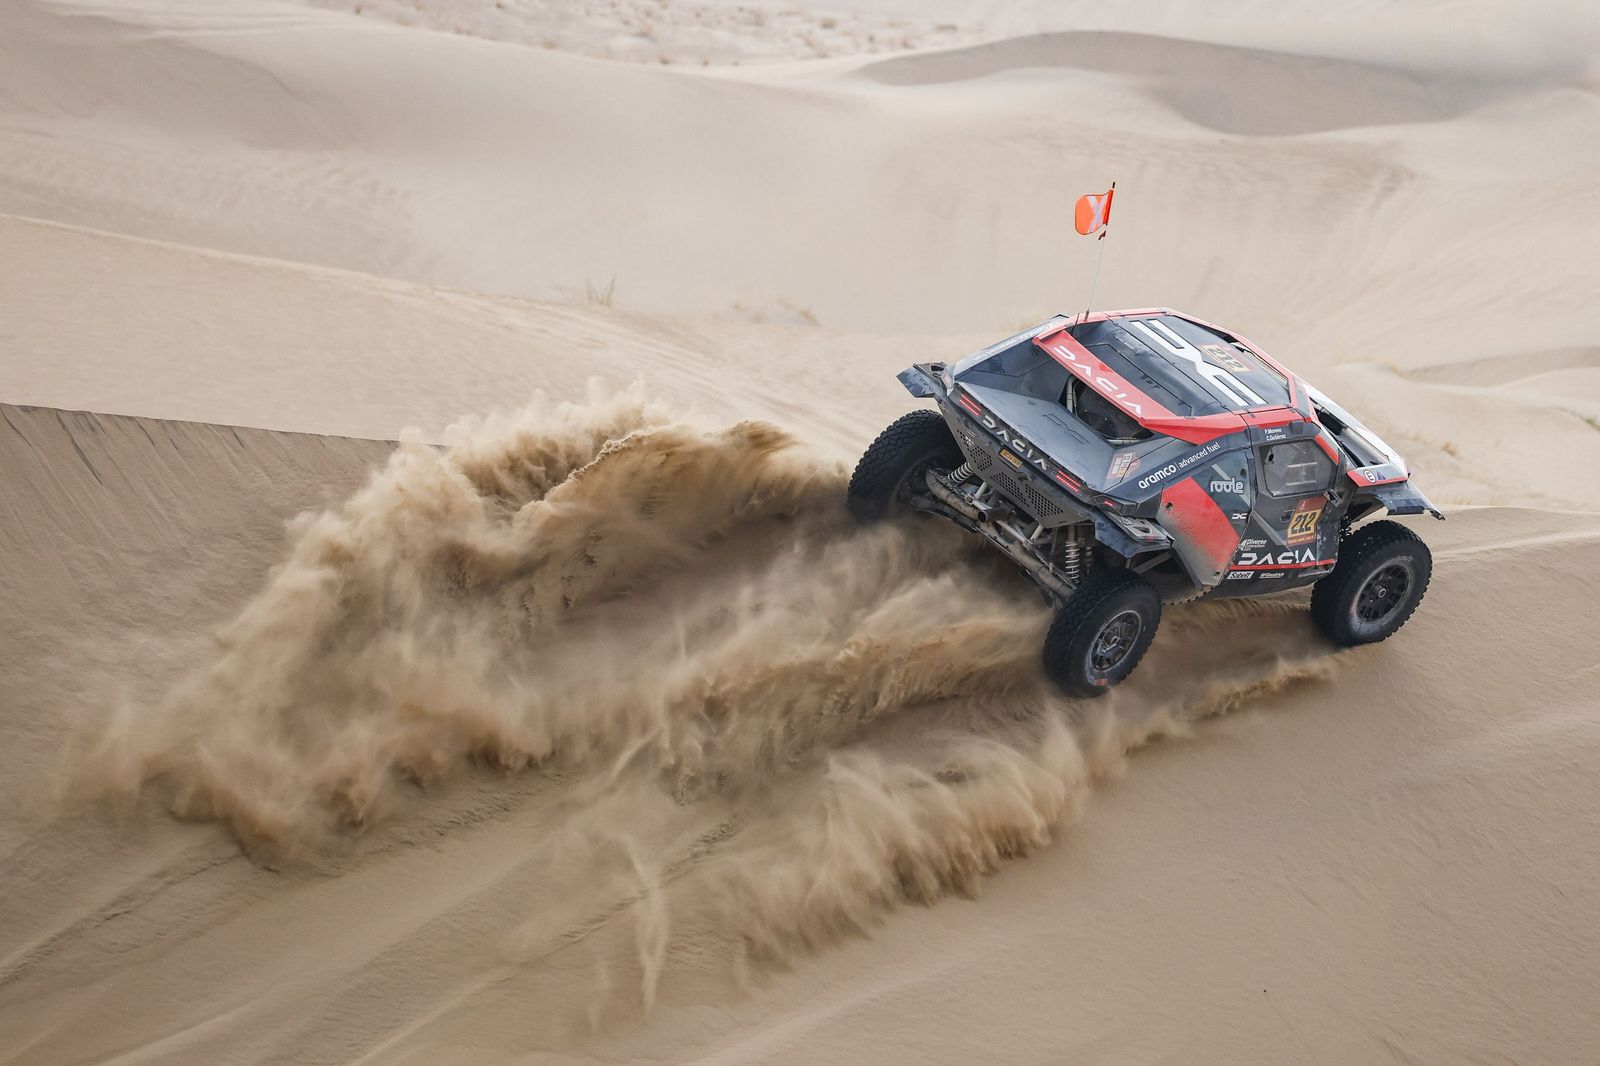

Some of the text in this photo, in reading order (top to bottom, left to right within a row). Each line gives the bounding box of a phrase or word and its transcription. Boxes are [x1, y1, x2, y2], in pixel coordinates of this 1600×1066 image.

[1053, 345, 1143, 416] DACIA
[982, 415, 1048, 471] DACIA
[1138, 464, 1177, 489] aramco
[1179, 449, 1208, 469] advanced
[1207, 442, 1221, 454] fuel
[1210, 477, 1244, 494] roole
[1291, 512, 1317, 534] 212
[1238, 548, 1316, 565] DACIA
